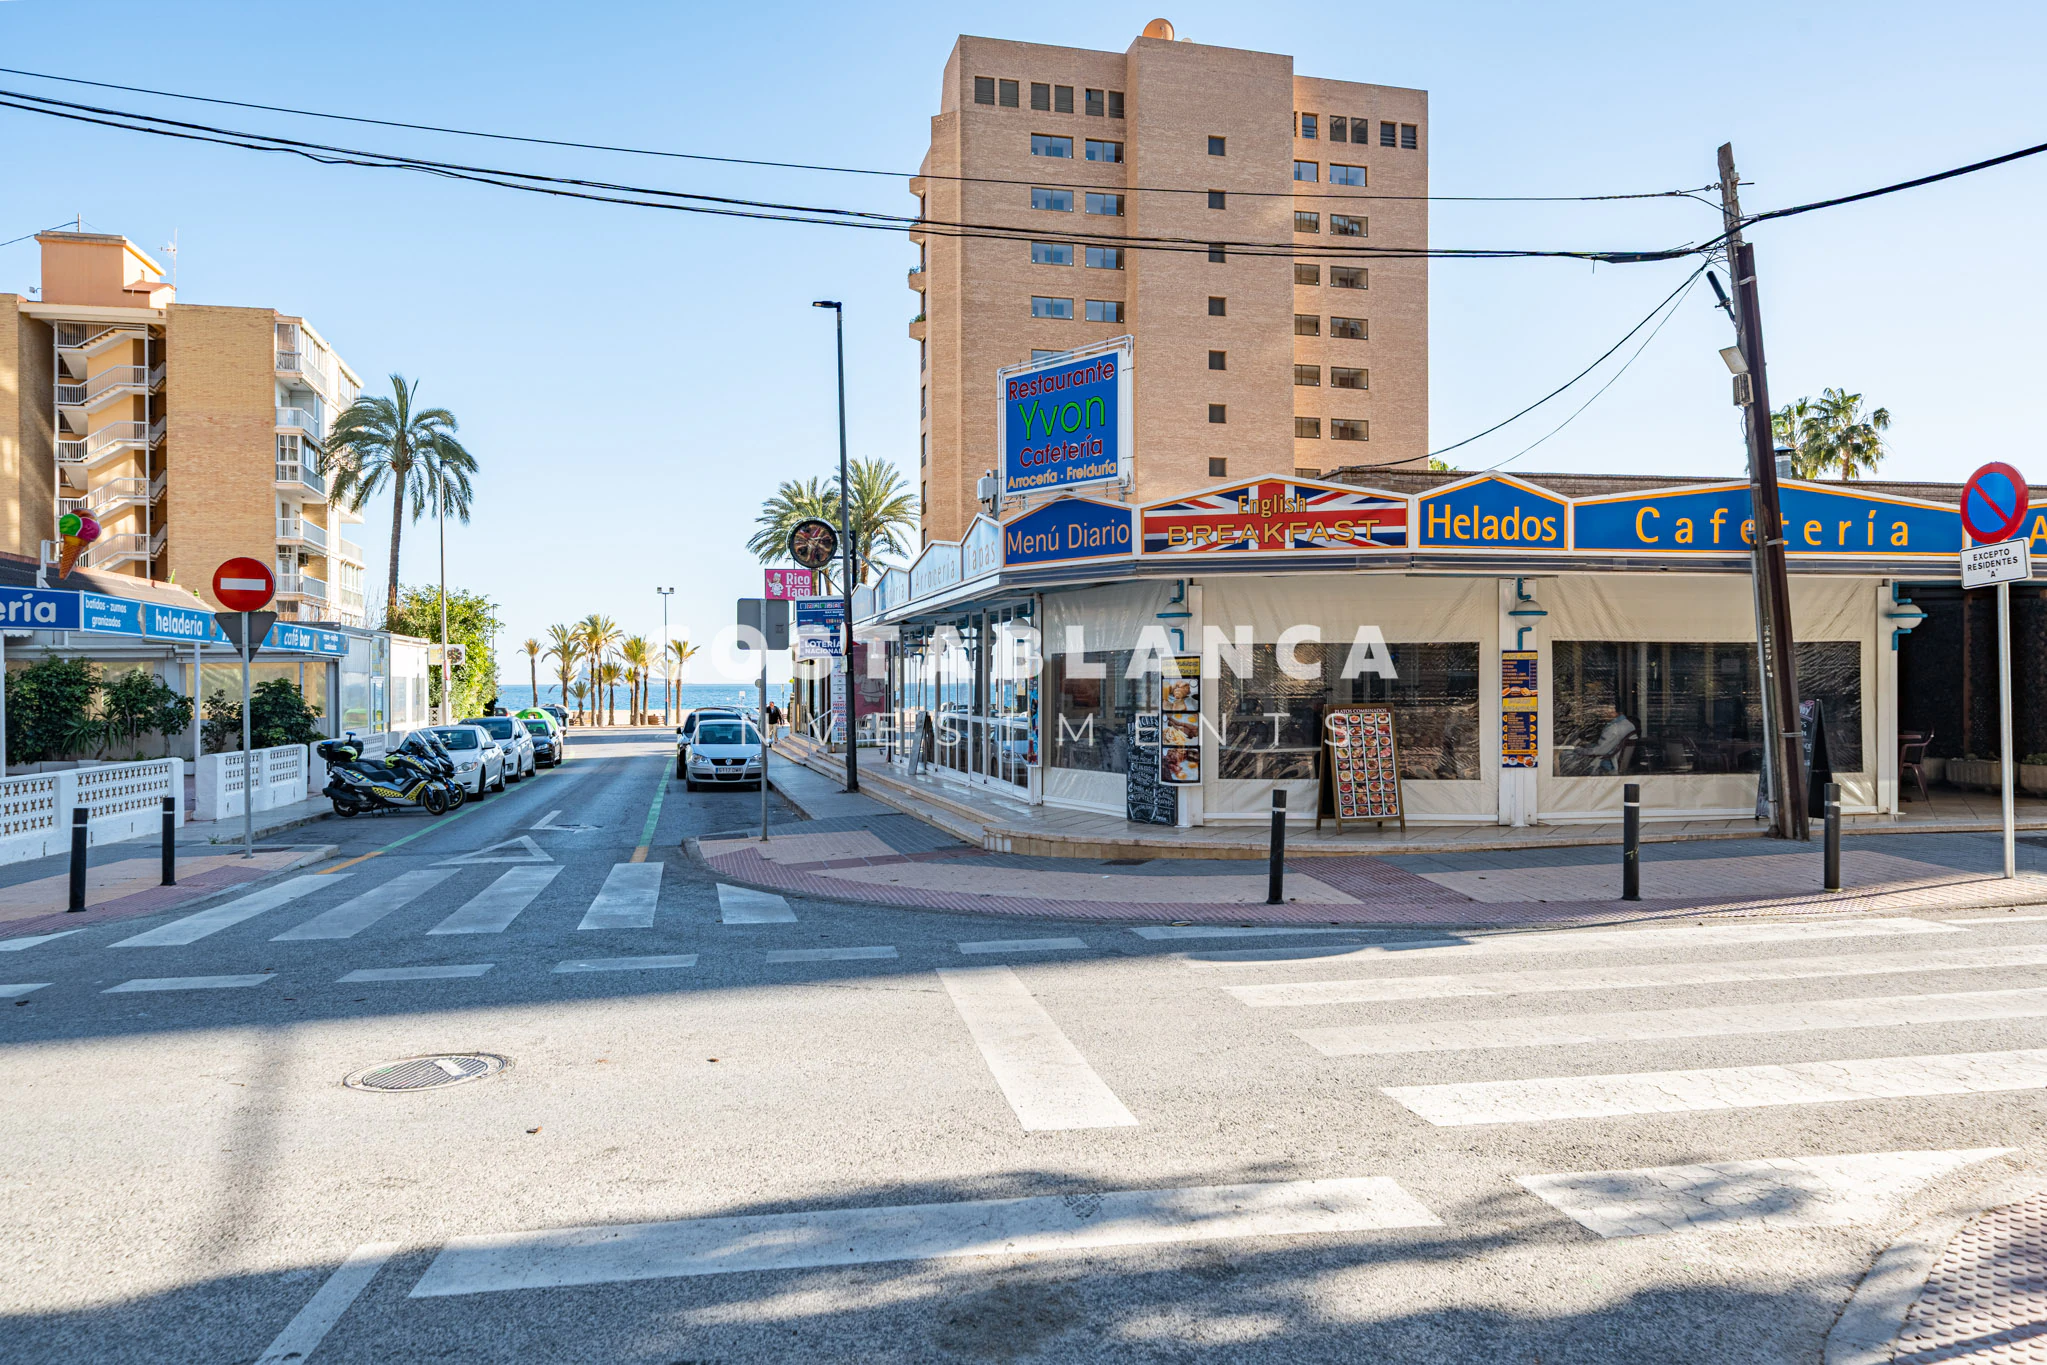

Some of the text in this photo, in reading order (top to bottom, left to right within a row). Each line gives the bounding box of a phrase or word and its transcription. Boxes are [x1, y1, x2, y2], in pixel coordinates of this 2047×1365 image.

[1008, 360, 1115, 401] Restaurante
[1018, 396, 1105, 440] Yvon
[1020, 434, 1103, 467] Cafetería
[1007, 469, 1058, 489] Arrocería
[1238, 493, 1307, 518] English
[1167, 519, 1381, 546] BREAKFAST
[1428, 504, 1557, 541] Helados
[1007, 519, 1130, 556] Menú Diario
[966, 541, 996, 573] Tapas
[1967, 556, 2018, 571] RESIDENTES
[1973, 548, 2010, 561] EXCEPTO
[786, 572, 810, 585] Rico
[915, 554, 955, 592] Arrocería
[786, 585, 810, 597] Taco
[85, 597, 106, 610] batidos
[110, 603, 127, 613] zumos
[92, 615, 121, 628] granizados
[155, 608, 203, 636] heladeria
[284, 629, 299, 646] café
[300, 631, 310, 647] bar
[805, 639, 841, 648] LOTERÍA
